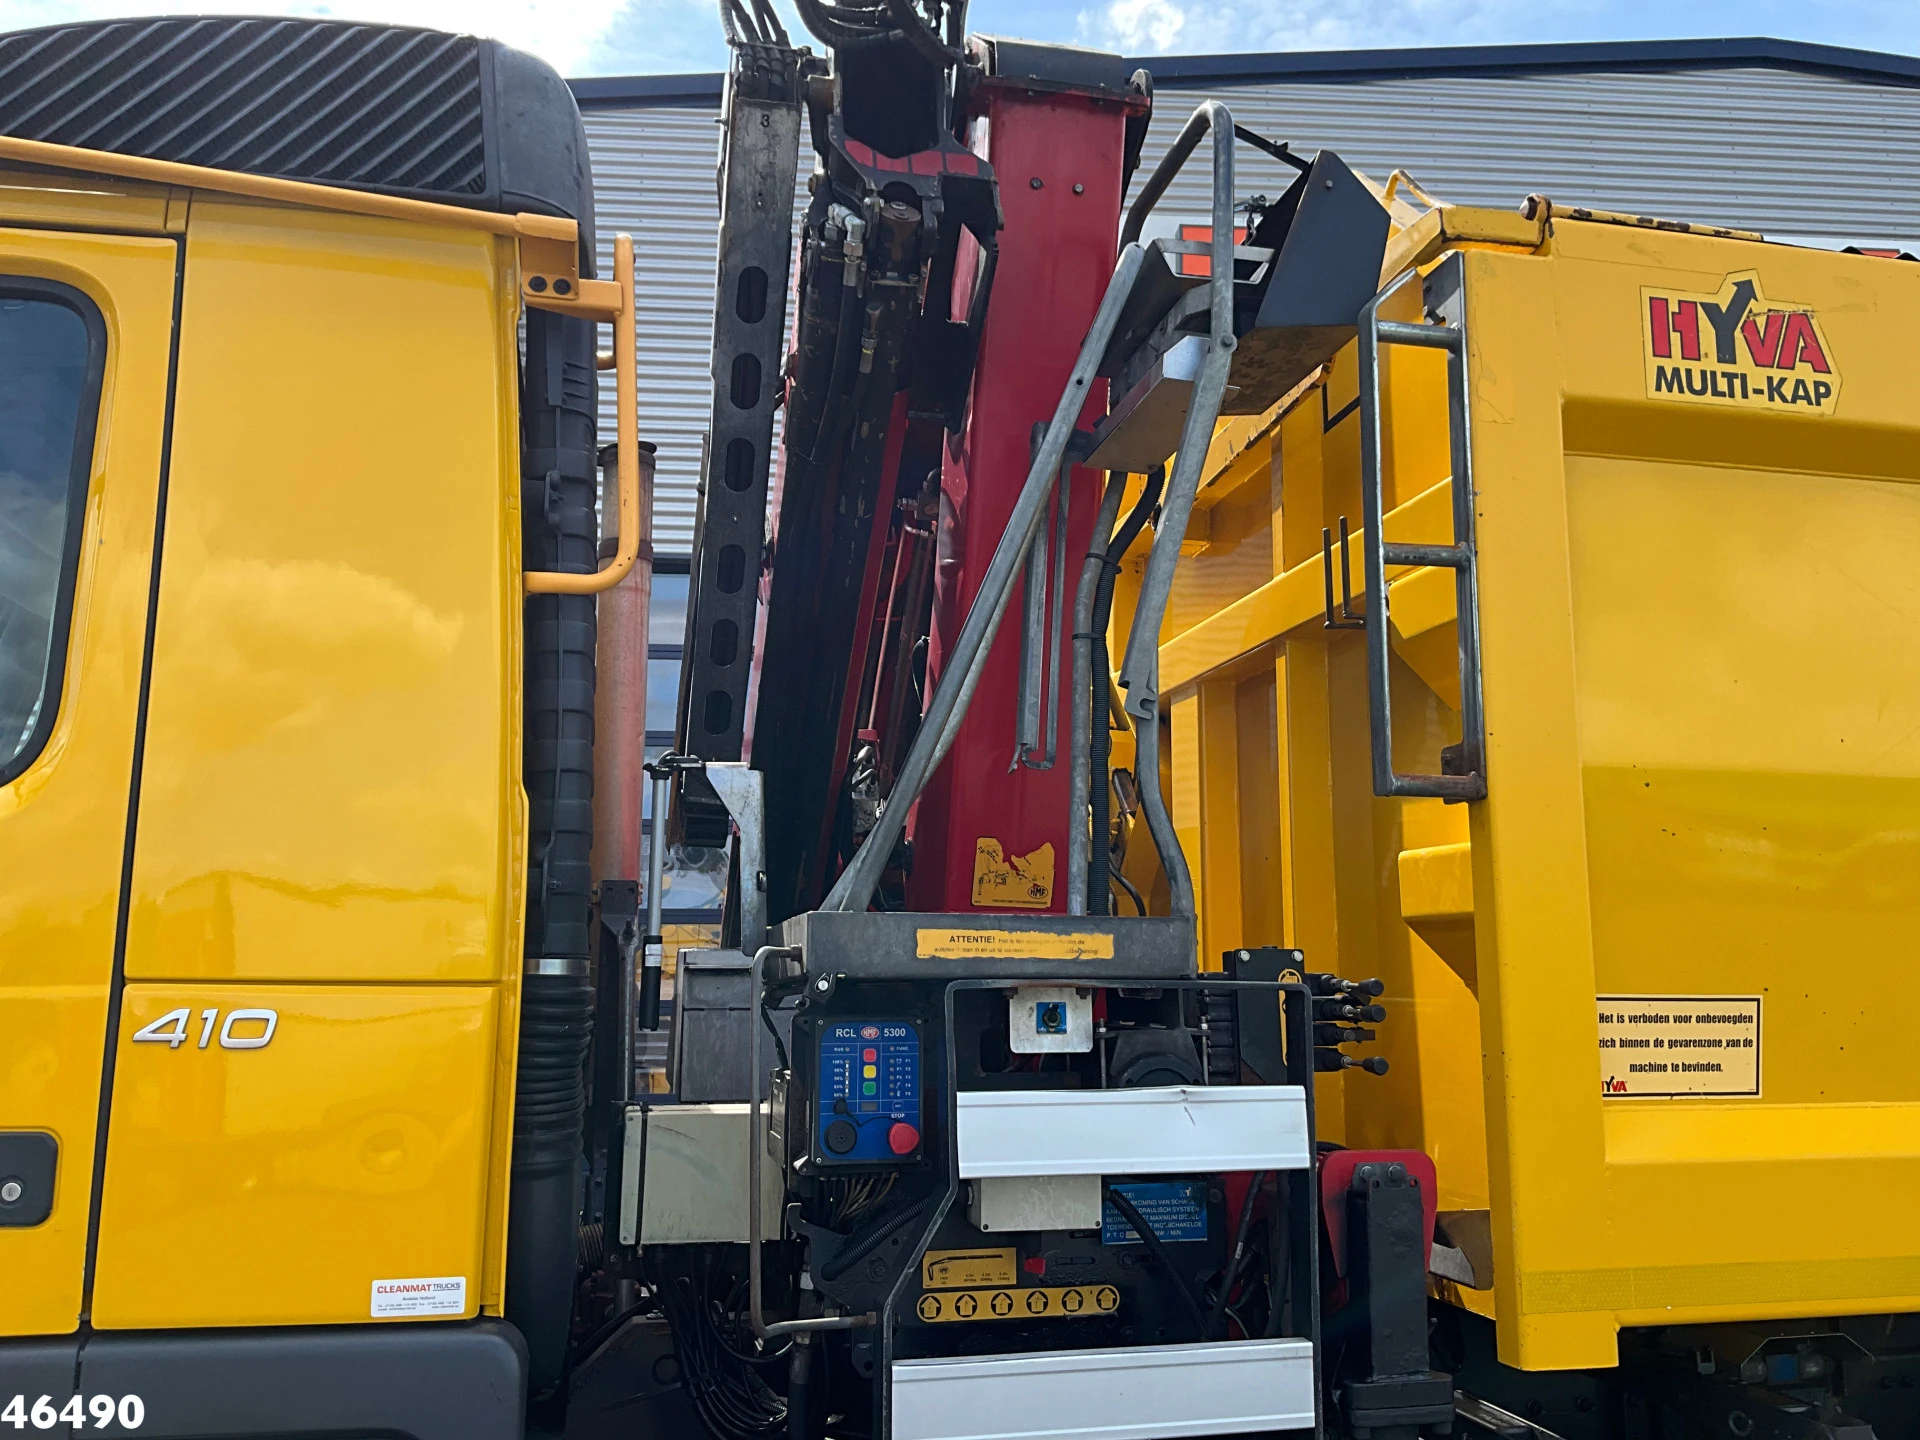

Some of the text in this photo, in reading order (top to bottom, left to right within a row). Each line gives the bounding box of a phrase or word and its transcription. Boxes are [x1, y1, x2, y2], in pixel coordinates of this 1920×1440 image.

[1648, 279, 1832, 374] HYVA
[1654, 365, 1832, 407] MULTI-KAP
[1030, 886, 1046, 897] HMF
[949, 935, 996, 943] ATTENTIE!
[1598, 1012, 1754, 1025] Het is verboden voor onbevoegden
[132, 1008, 278, 1049] 410
[835, 1027, 906, 1038] RCL HMF 5300
[1598, 1037, 1753, 1049] zich binnen de gevarenzone van de
[1629, 1061, 1723, 1073] machine te bevinden.
[376, 1282, 461, 1294] CLEANMAT TRUCKS
